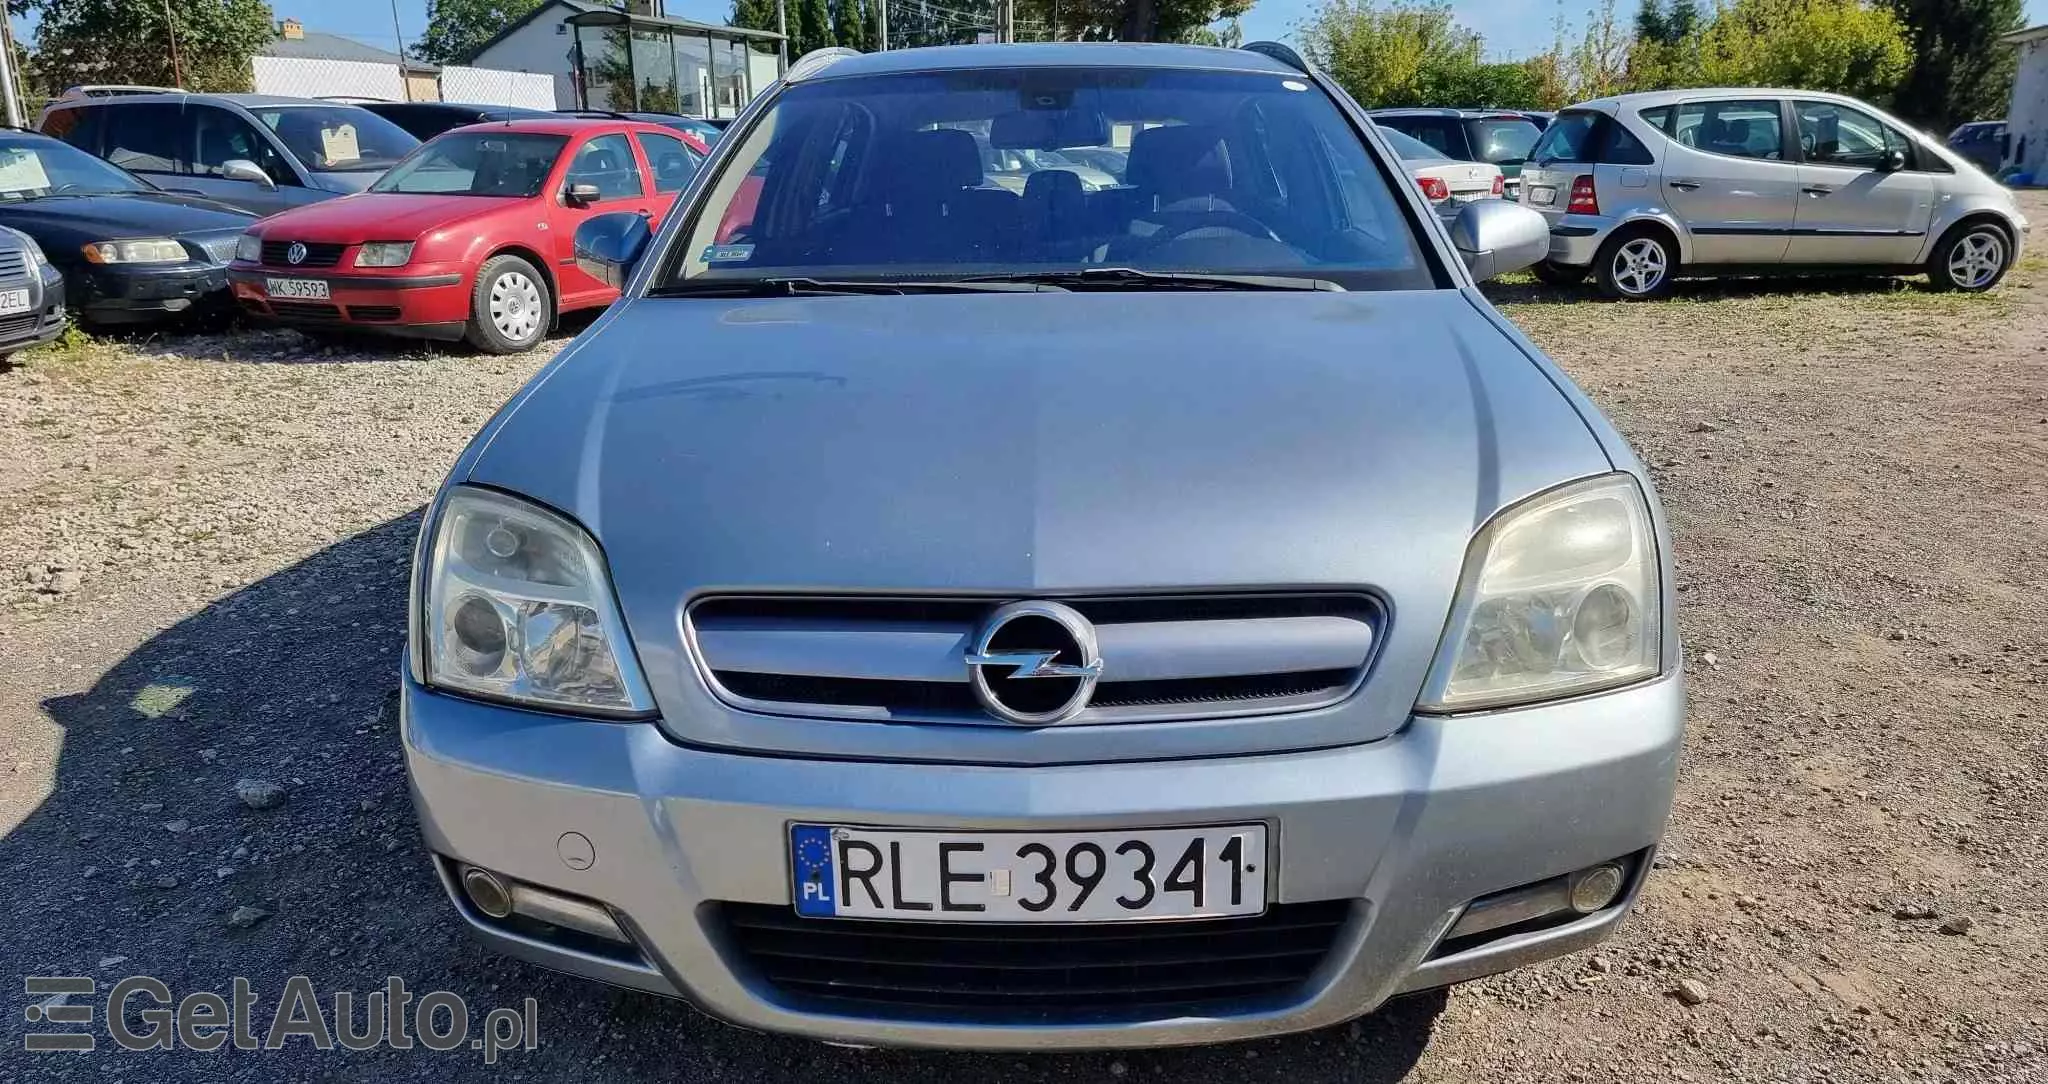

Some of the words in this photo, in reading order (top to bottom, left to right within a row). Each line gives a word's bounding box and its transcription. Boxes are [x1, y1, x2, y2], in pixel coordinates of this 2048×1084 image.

[803, 882, 830, 901] PL
[838, 840, 986, 912] RLE
[1015, 836, 1242, 912] 39341
